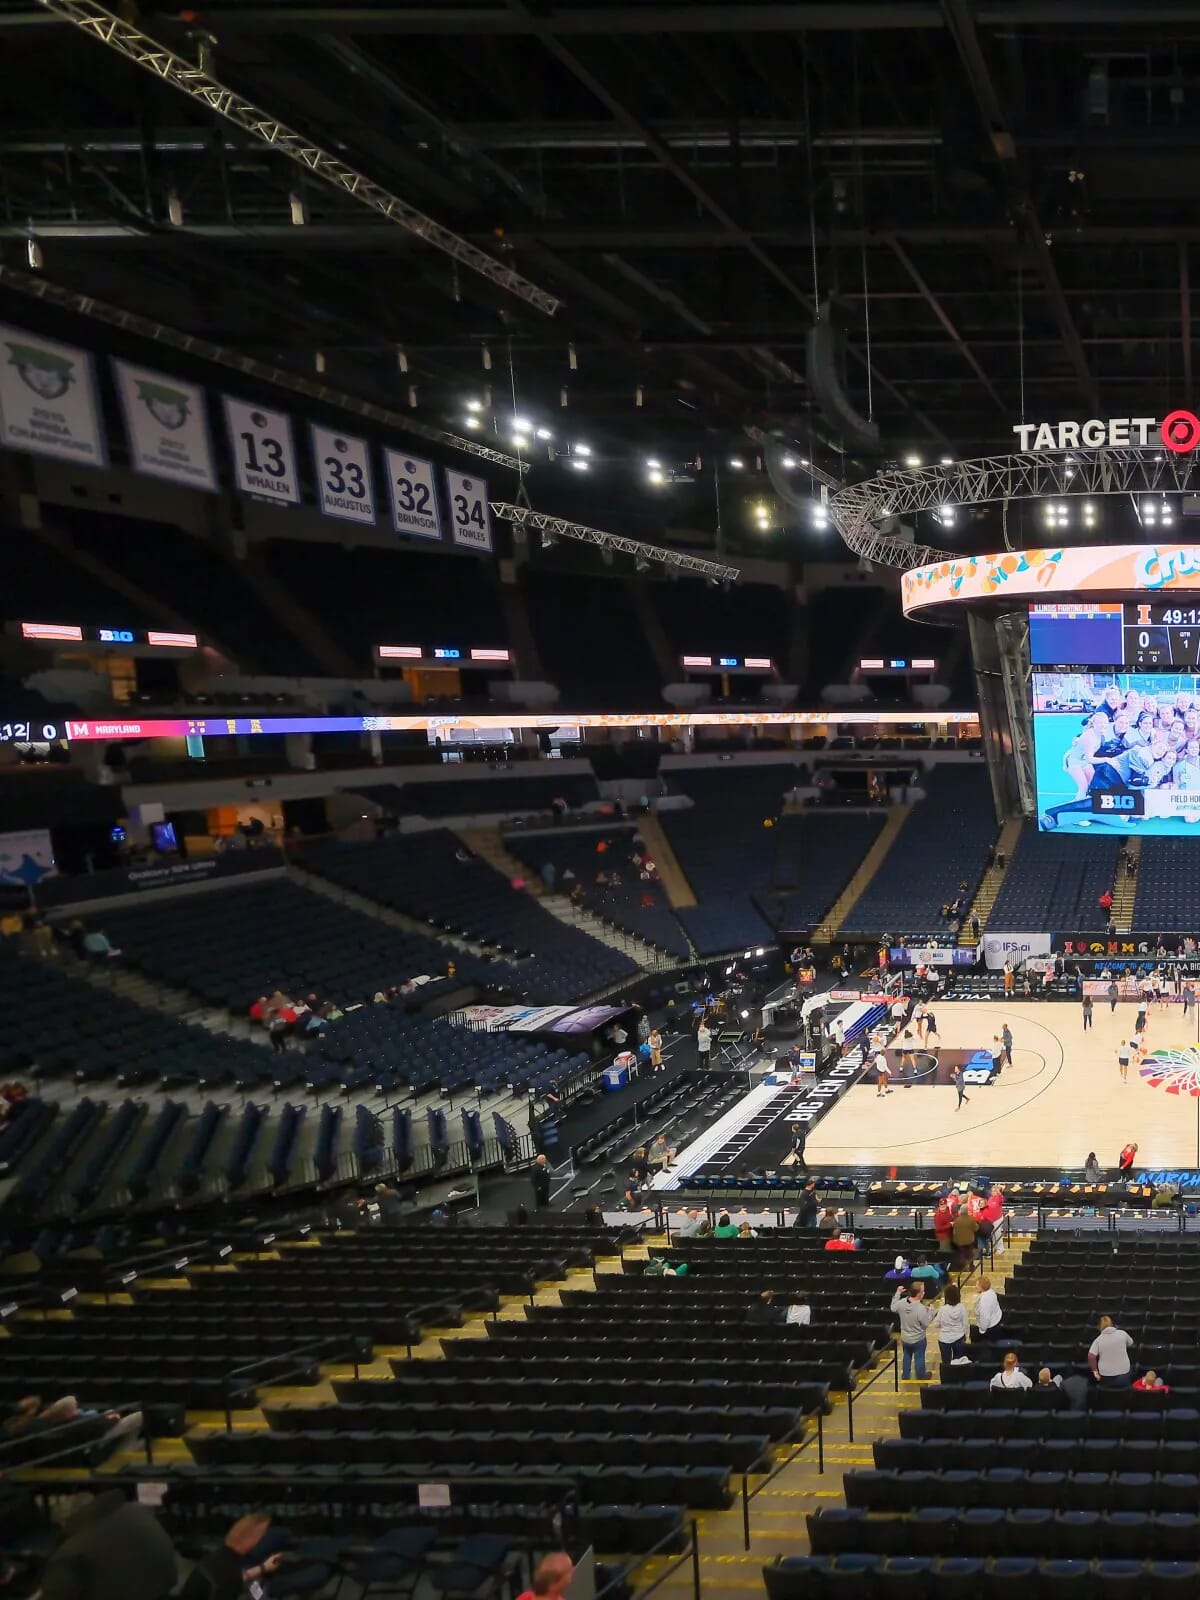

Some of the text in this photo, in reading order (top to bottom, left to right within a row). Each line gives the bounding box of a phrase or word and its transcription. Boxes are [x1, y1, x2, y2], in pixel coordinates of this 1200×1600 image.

[1013, 418, 1156, 451] TARGET
[240, 432, 286, 477] 13
[246, 474, 290, 494] WHALEN
[325, 456, 366, 499] 33
[326, 494, 372, 514] AUGUSTUS
[397, 477, 433, 516] 32
[397, 512, 437, 529] BRUNSON
[454, 495, 486, 529] 34
[458, 527, 486, 542] FOWLES
[1138, 631, 1150, 648] 0
[1183, 639, 1189, 649] 1
[42, 724, 57, 740] 0
[73, 724, 89, 736] M
[95, 725, 142, 735] MARYLAND
[1170, 794, 1188, 803] FIELD
[1190, 963, 1200, 971] BIG
[783, 1101, 825, 1121] BIG
[806, 1079, 847, 1099] TEN
